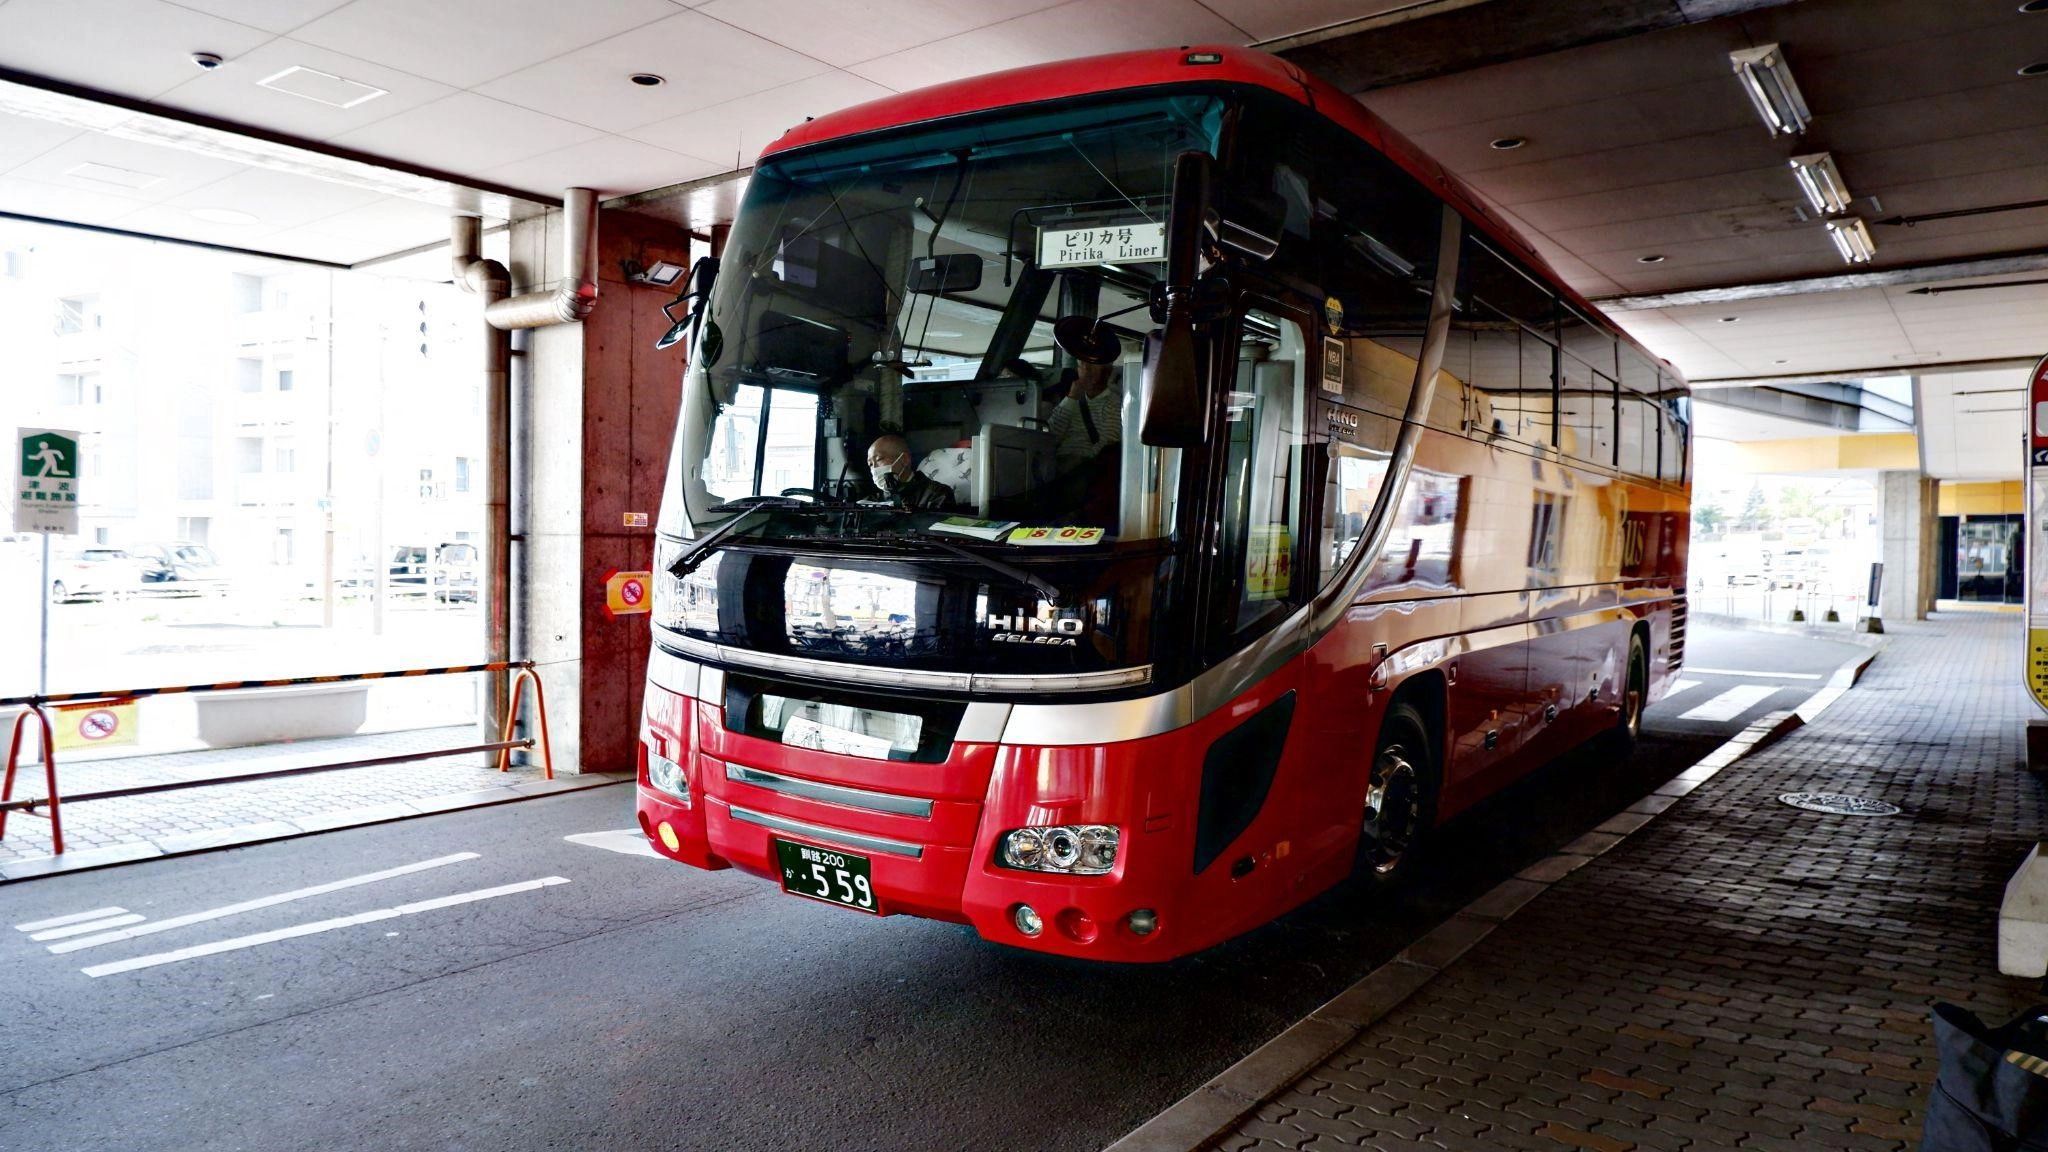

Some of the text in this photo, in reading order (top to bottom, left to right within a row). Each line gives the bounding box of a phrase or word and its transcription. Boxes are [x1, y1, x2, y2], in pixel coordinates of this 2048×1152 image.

[1066, 228, 1132, 248] ピリカ号
[1060, 245, 1158, 261] Pirika Liner
[1327, 409, 1358, 428] HINO
[1031, 529, 1099, 539] 8 05
[988, 613, 1083, 635] HINO
[993, 633, 1076, 647] SELEGA
[785, 868, 795, 879] か
